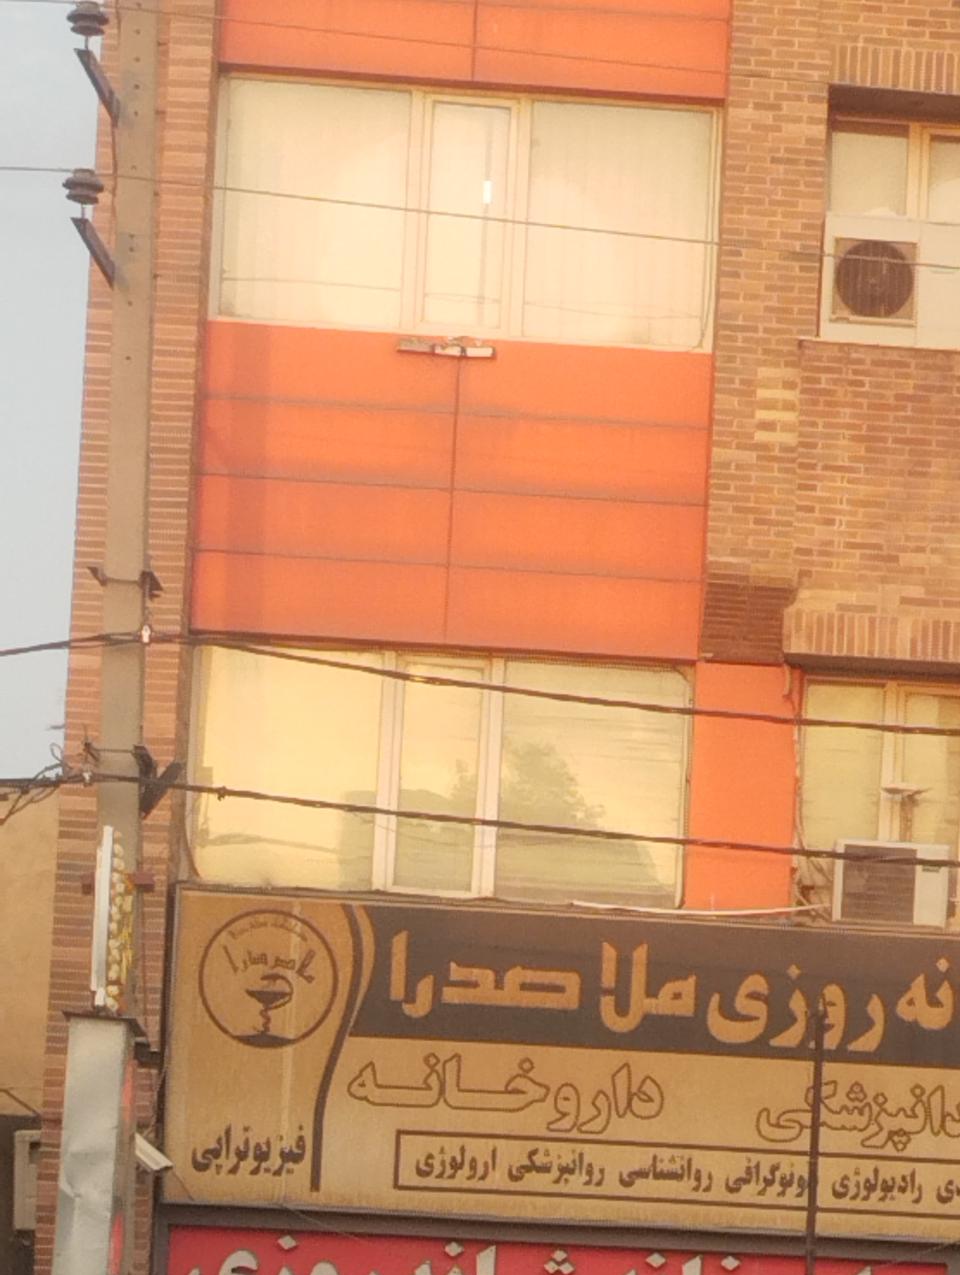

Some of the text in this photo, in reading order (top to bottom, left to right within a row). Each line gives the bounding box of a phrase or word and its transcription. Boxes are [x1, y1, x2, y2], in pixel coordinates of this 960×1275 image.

[390, 930, 582, 1019] صدرا
[706, 963, 885, 1053] روزی
[347, 1052, 665, 1134] داروخانه
[190, 1123, 306, 1177] فیزیوتراپی
[415, 1143, 497, 1181] ارولوژی
[507, 1147, 606, 1187] روانپزشکی
[618, 1153, 713, 1193] روانشناسی
[724, 1156, 816, 1199] ونوگرافی
[831, 1166, 923, 1204] رادیولوژی
